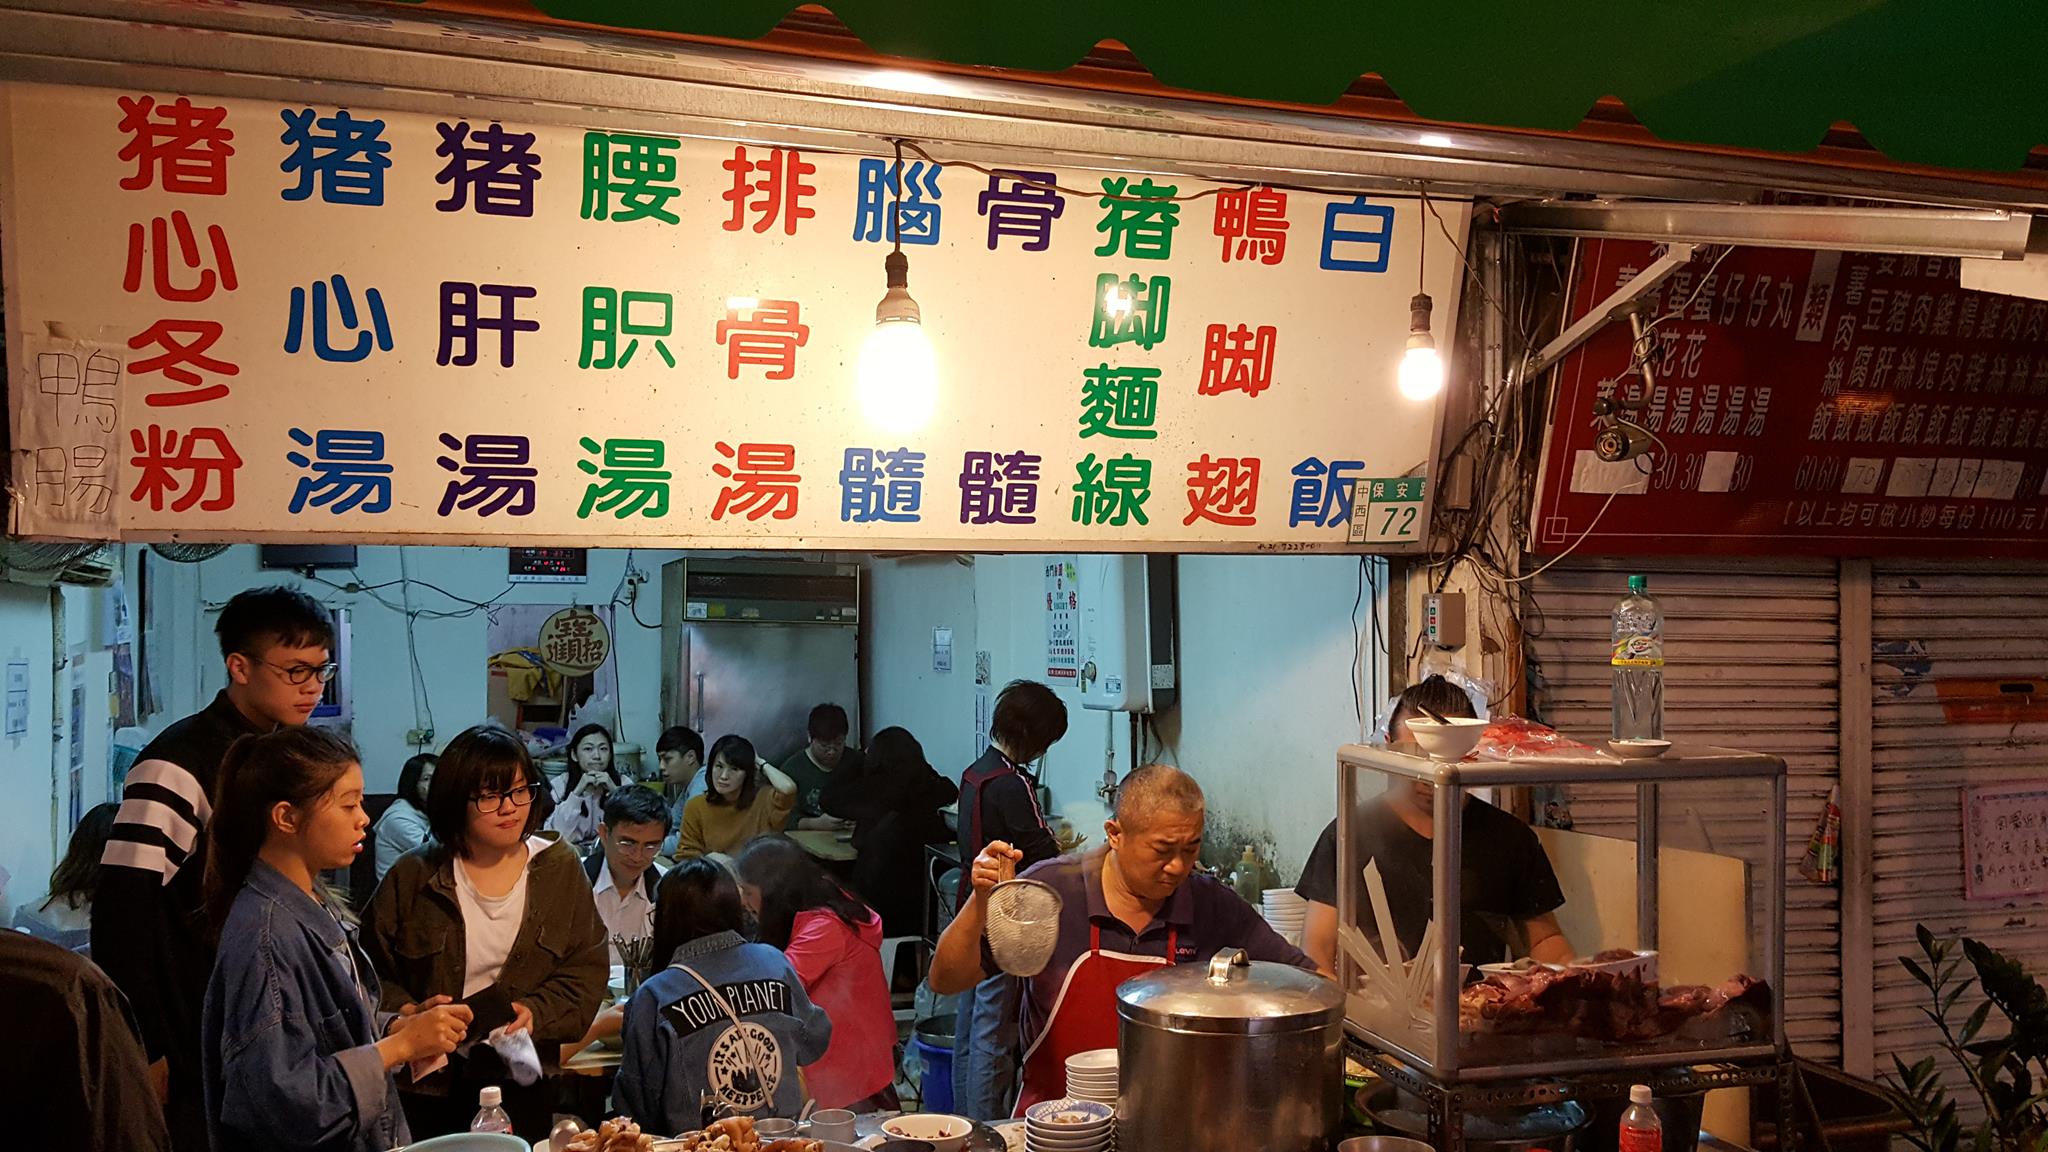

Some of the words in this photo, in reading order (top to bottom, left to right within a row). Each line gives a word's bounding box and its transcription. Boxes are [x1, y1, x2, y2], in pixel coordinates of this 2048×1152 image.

[117, 94, 243, 513] 猪心冬粉
[280, 108, 394, 515] 猪心湯
[434, 121, 542, 517] 猪肝湯
[709, 146, 817, 522] 排骨湯
[1380, 507, 1417, 536] 72
[726, 981, 785, 1015] PLANET
[750, 1028, 776, 1053] GOOD
